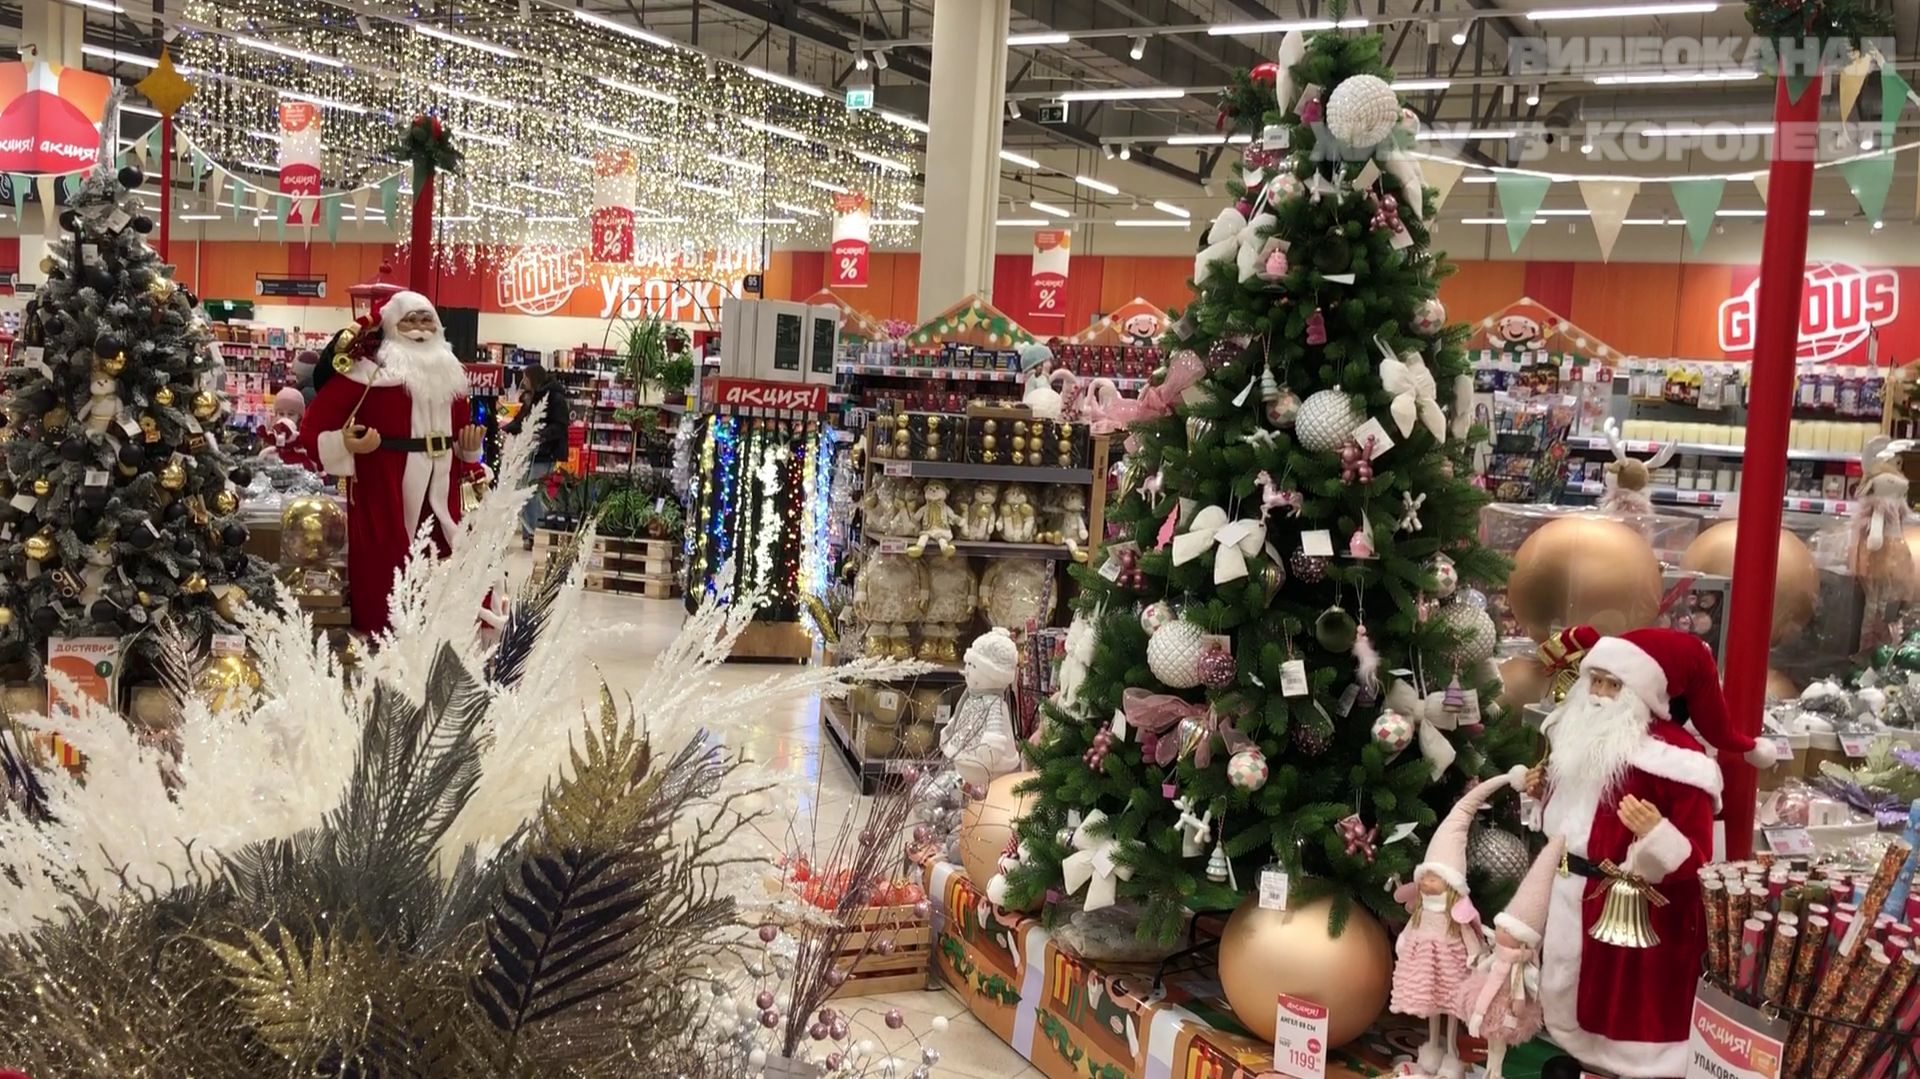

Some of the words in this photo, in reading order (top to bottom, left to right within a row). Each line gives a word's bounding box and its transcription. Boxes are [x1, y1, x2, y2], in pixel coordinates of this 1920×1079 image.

[0, 136, 35, 152] кция!
[40, 140, 100, 162] акция!
[1722, 270, 1897, 349] Gbus
[726, 386, 820, 410] акция!
[1698, 1016, 1752, 1059] акция!
[1289, 1049, 1315, 1070] 1199
[1694, 1050, 1741, 1079] УПАКОВ
